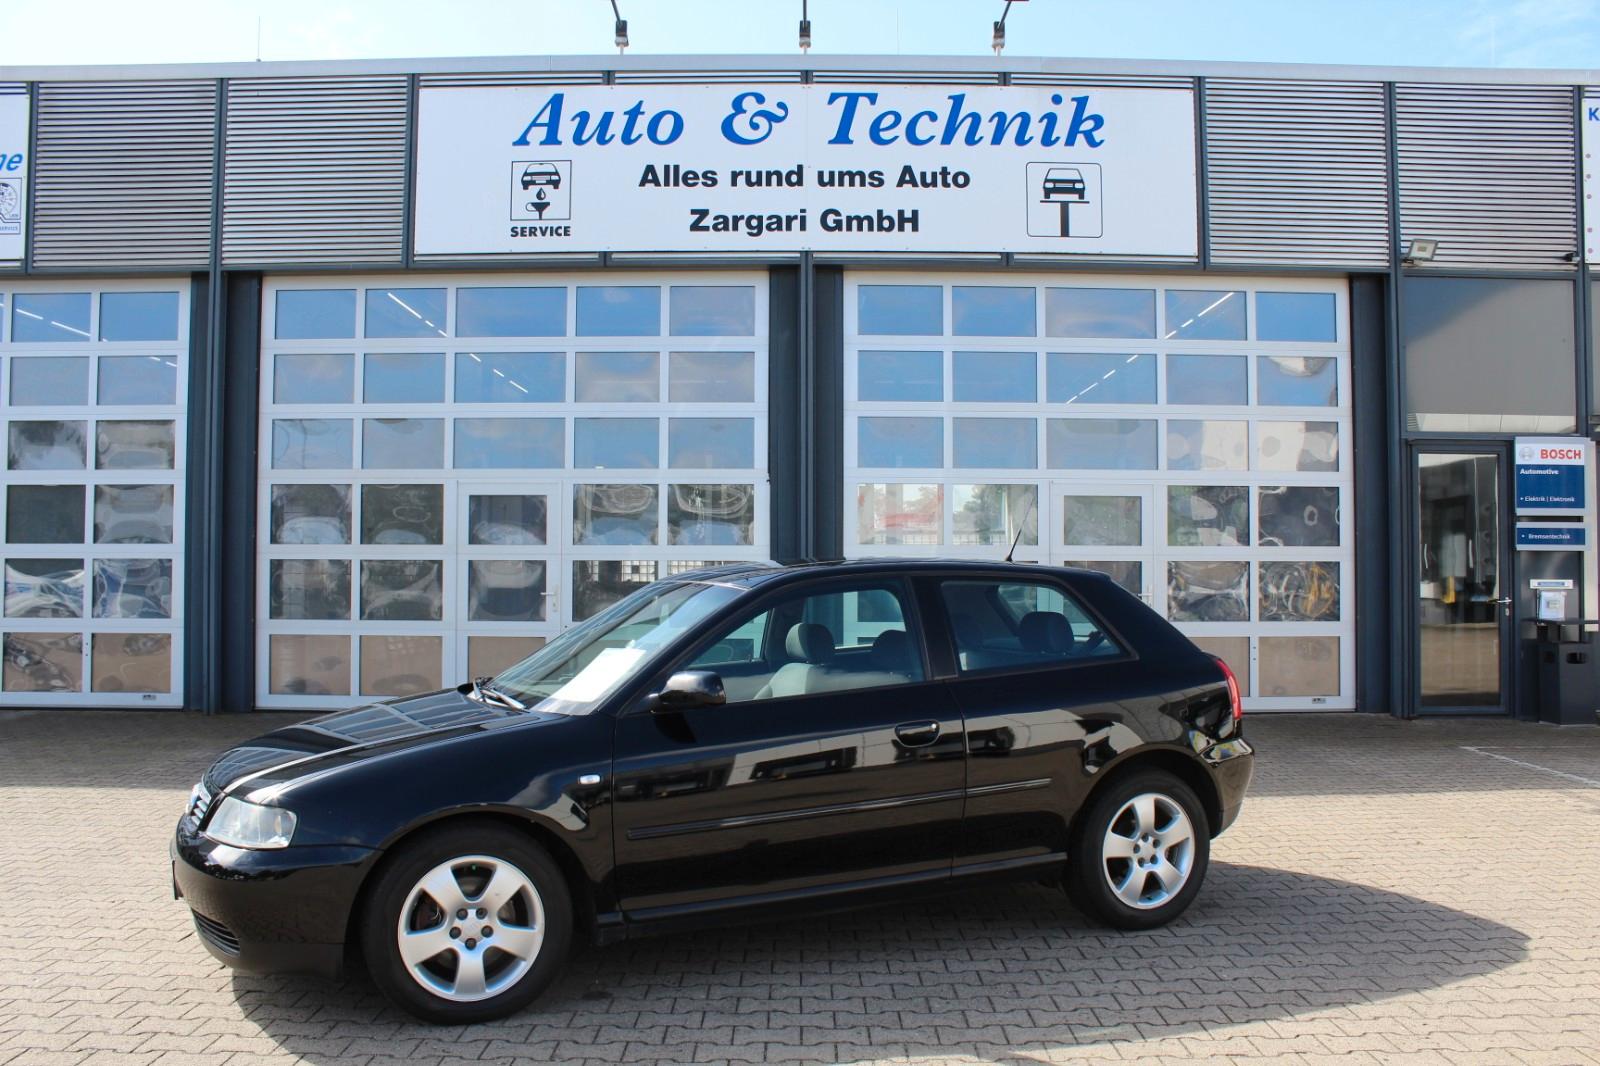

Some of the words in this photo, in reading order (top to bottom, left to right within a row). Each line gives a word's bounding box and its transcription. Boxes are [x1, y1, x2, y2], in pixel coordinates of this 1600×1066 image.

[512, 93, 685, 146] Auto
[721, 91, 789, 145] &
[827, 92, 1105, 148] Technik
[639, 164, 718, 187] Alles
[731, 164, 804, 187] rund
[817, 169, 885, 188] ums
[896, 165, 970, 188] Auto
[510, 225, 571, 237] SERVICE
[689, 208, 807, 237] Zargari
[819, 208, 920, 232] GmbH
[1540, 449, 1582, 460] BOSCH
